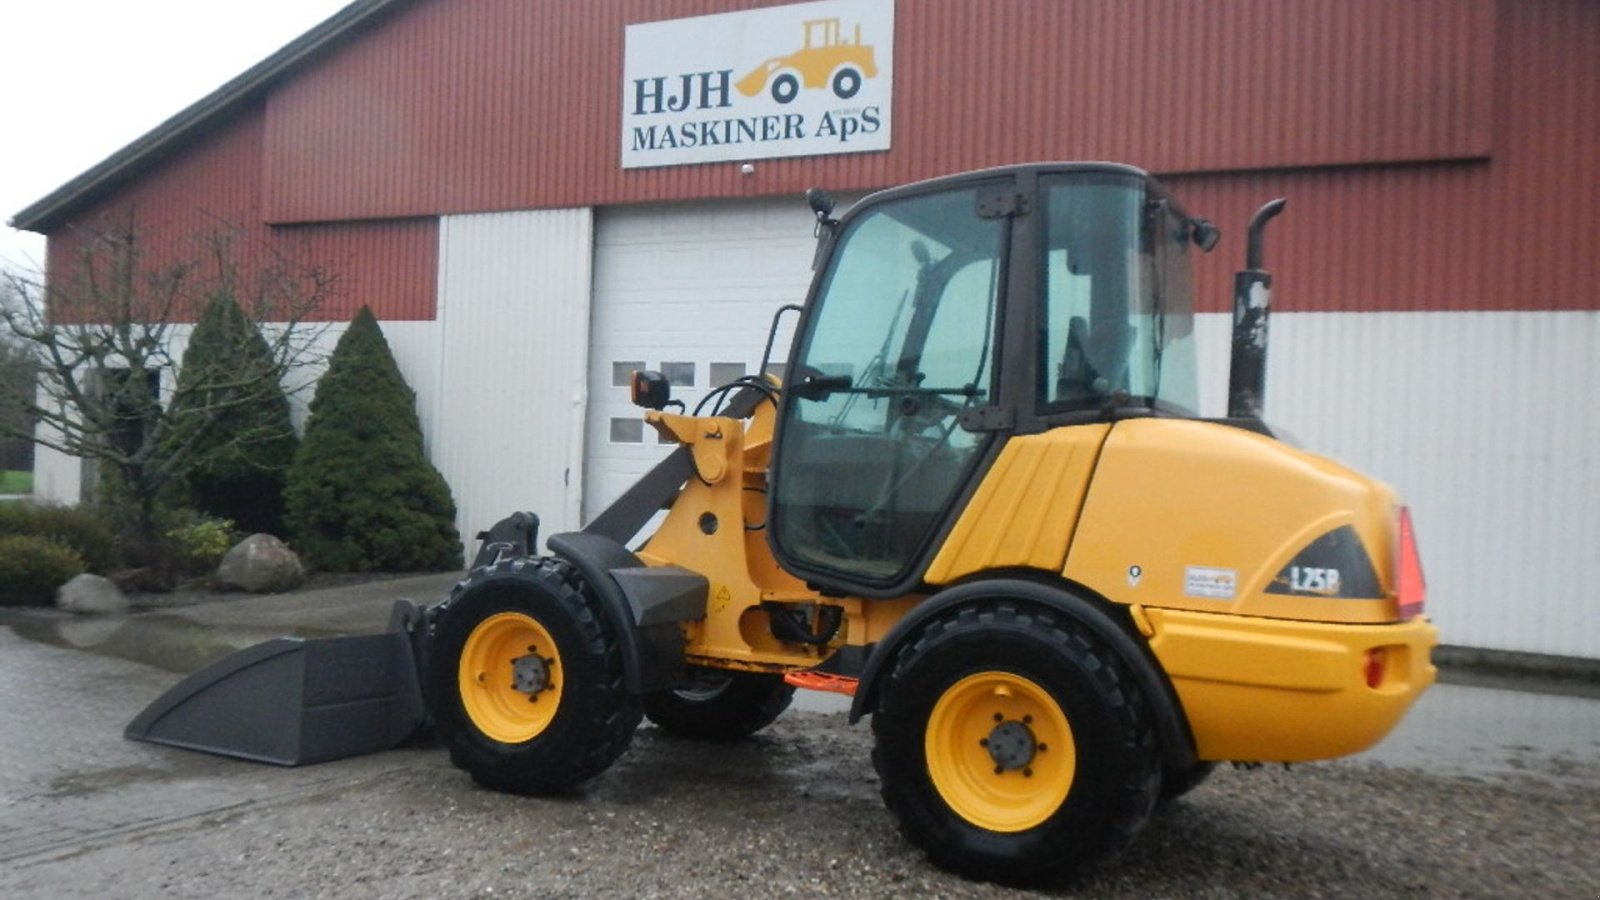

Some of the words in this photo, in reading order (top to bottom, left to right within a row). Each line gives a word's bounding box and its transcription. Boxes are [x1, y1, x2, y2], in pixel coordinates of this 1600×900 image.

[632, 69, 733, 115] HJH
[632, 114, 805, 151] MASKINER
[815, 105, 881, 142] ApS
